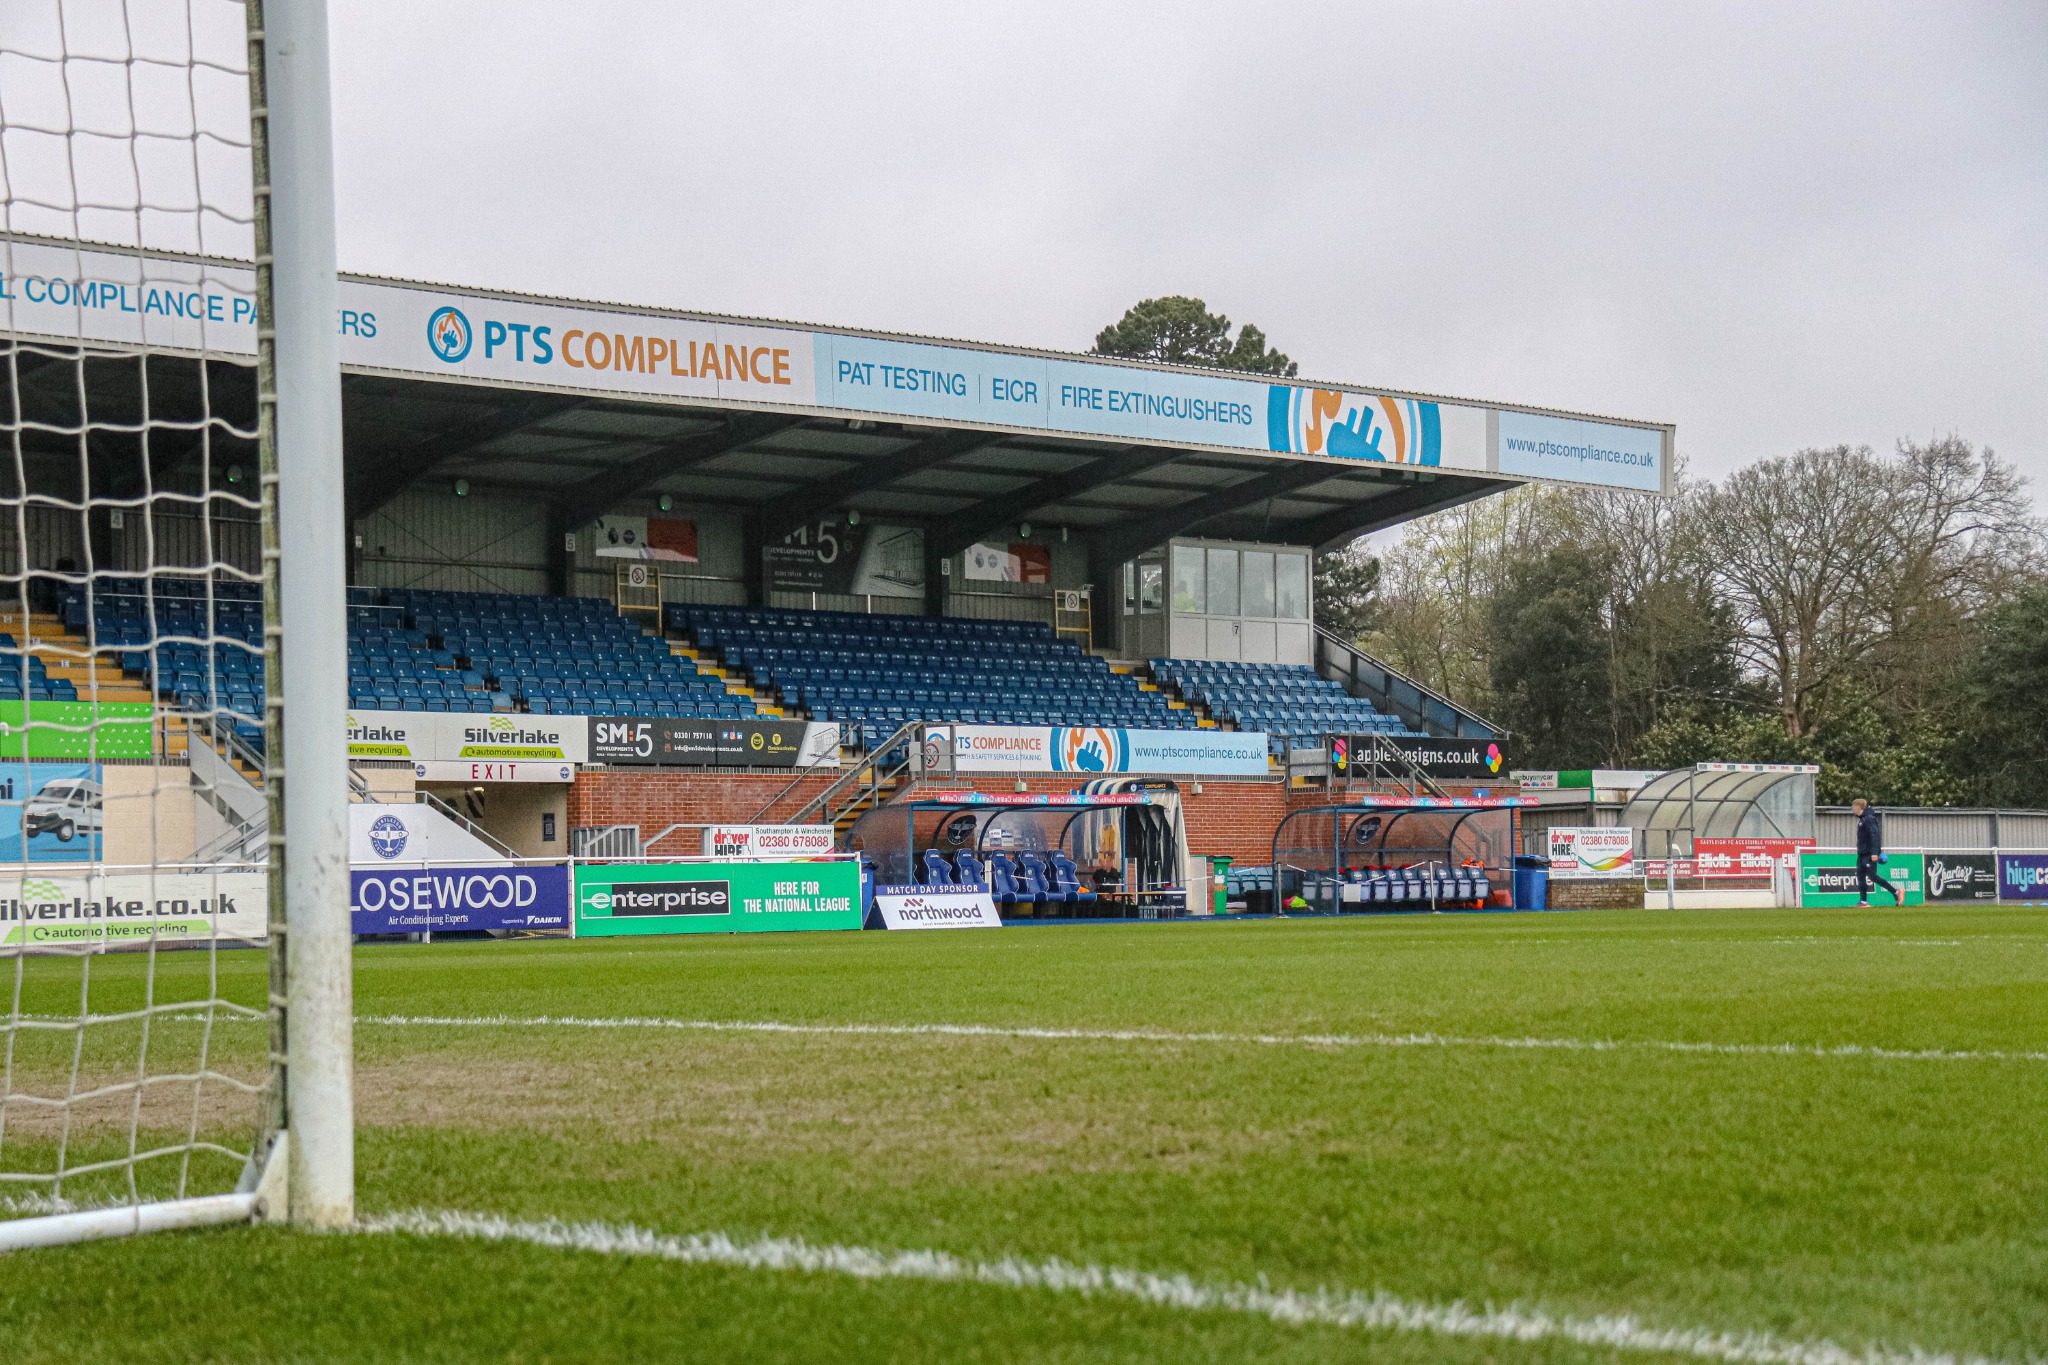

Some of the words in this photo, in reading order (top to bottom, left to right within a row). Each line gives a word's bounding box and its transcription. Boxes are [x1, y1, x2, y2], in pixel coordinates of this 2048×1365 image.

[25, 275, 224, 322] COMPLIANCE
[485, 320, 553, 364] PTS
[562, 329, 791, 385] COMPLIANCE
[838, 361, 875, 386] PAT
[880, 365, 966, 396] TESTING
[993, 378, 1037, 404] EICR
[1061, 385, 1103, 411] FIRE
[1108, 390, 1253, 426] EXTINGUISHERS
[1506, 438, 1654, 467] www.ptscompliance.co.uk
[464, 728, 560, 744] Silverlake
[973, 737, 1042, 750] COMPLIANCE
[366, 746, 403, 756] recycling
[475, 749, 521, 757] automotive
[522, 750, 557, 759] recycling
[1134, 745, 1262, 762] www.ptscompliance.co.uk
[471, 764, 517, 780] EXIT
[714, 828, 750, 845] driver
[755, 827, 794, 836] Southampton
[800, 827, 833, 835] Winchester
[1551, 830, 1576, 844] driver
[759, 835, 790, 847] 02380
[792, 835, 829, 847] 678088
[1581, 835, 1603, 846] 02380
[1603, 835, 1630, 846] 678088
[1551, 844, 1571, 856] HIRE
[774, 881, 799, 896] HERE
[801, 881, 820, 895] FOR
[887, 885, 917, 894] MATCH
[919, 885, 937, 894] DAY
[939, 884, 979, 893] SPONSOR
[591, 887, 727, 911] enterprise
[743, 898, 762, 913] THE
[765, 897, 812, 913] NATIONAL
[815, 897, 851, 912] LEAGUE
[388, 916, 399, 925] Air
[400, 914, 444, 925] Conditioning
[444, 914, 469, 925] Experts
[533, 916, 562, 924] DAIKIN
[898, 903, 983, 921] northwood
[51, 924, 130, 939] automotive
[133, 923, 188, 938] recycling
